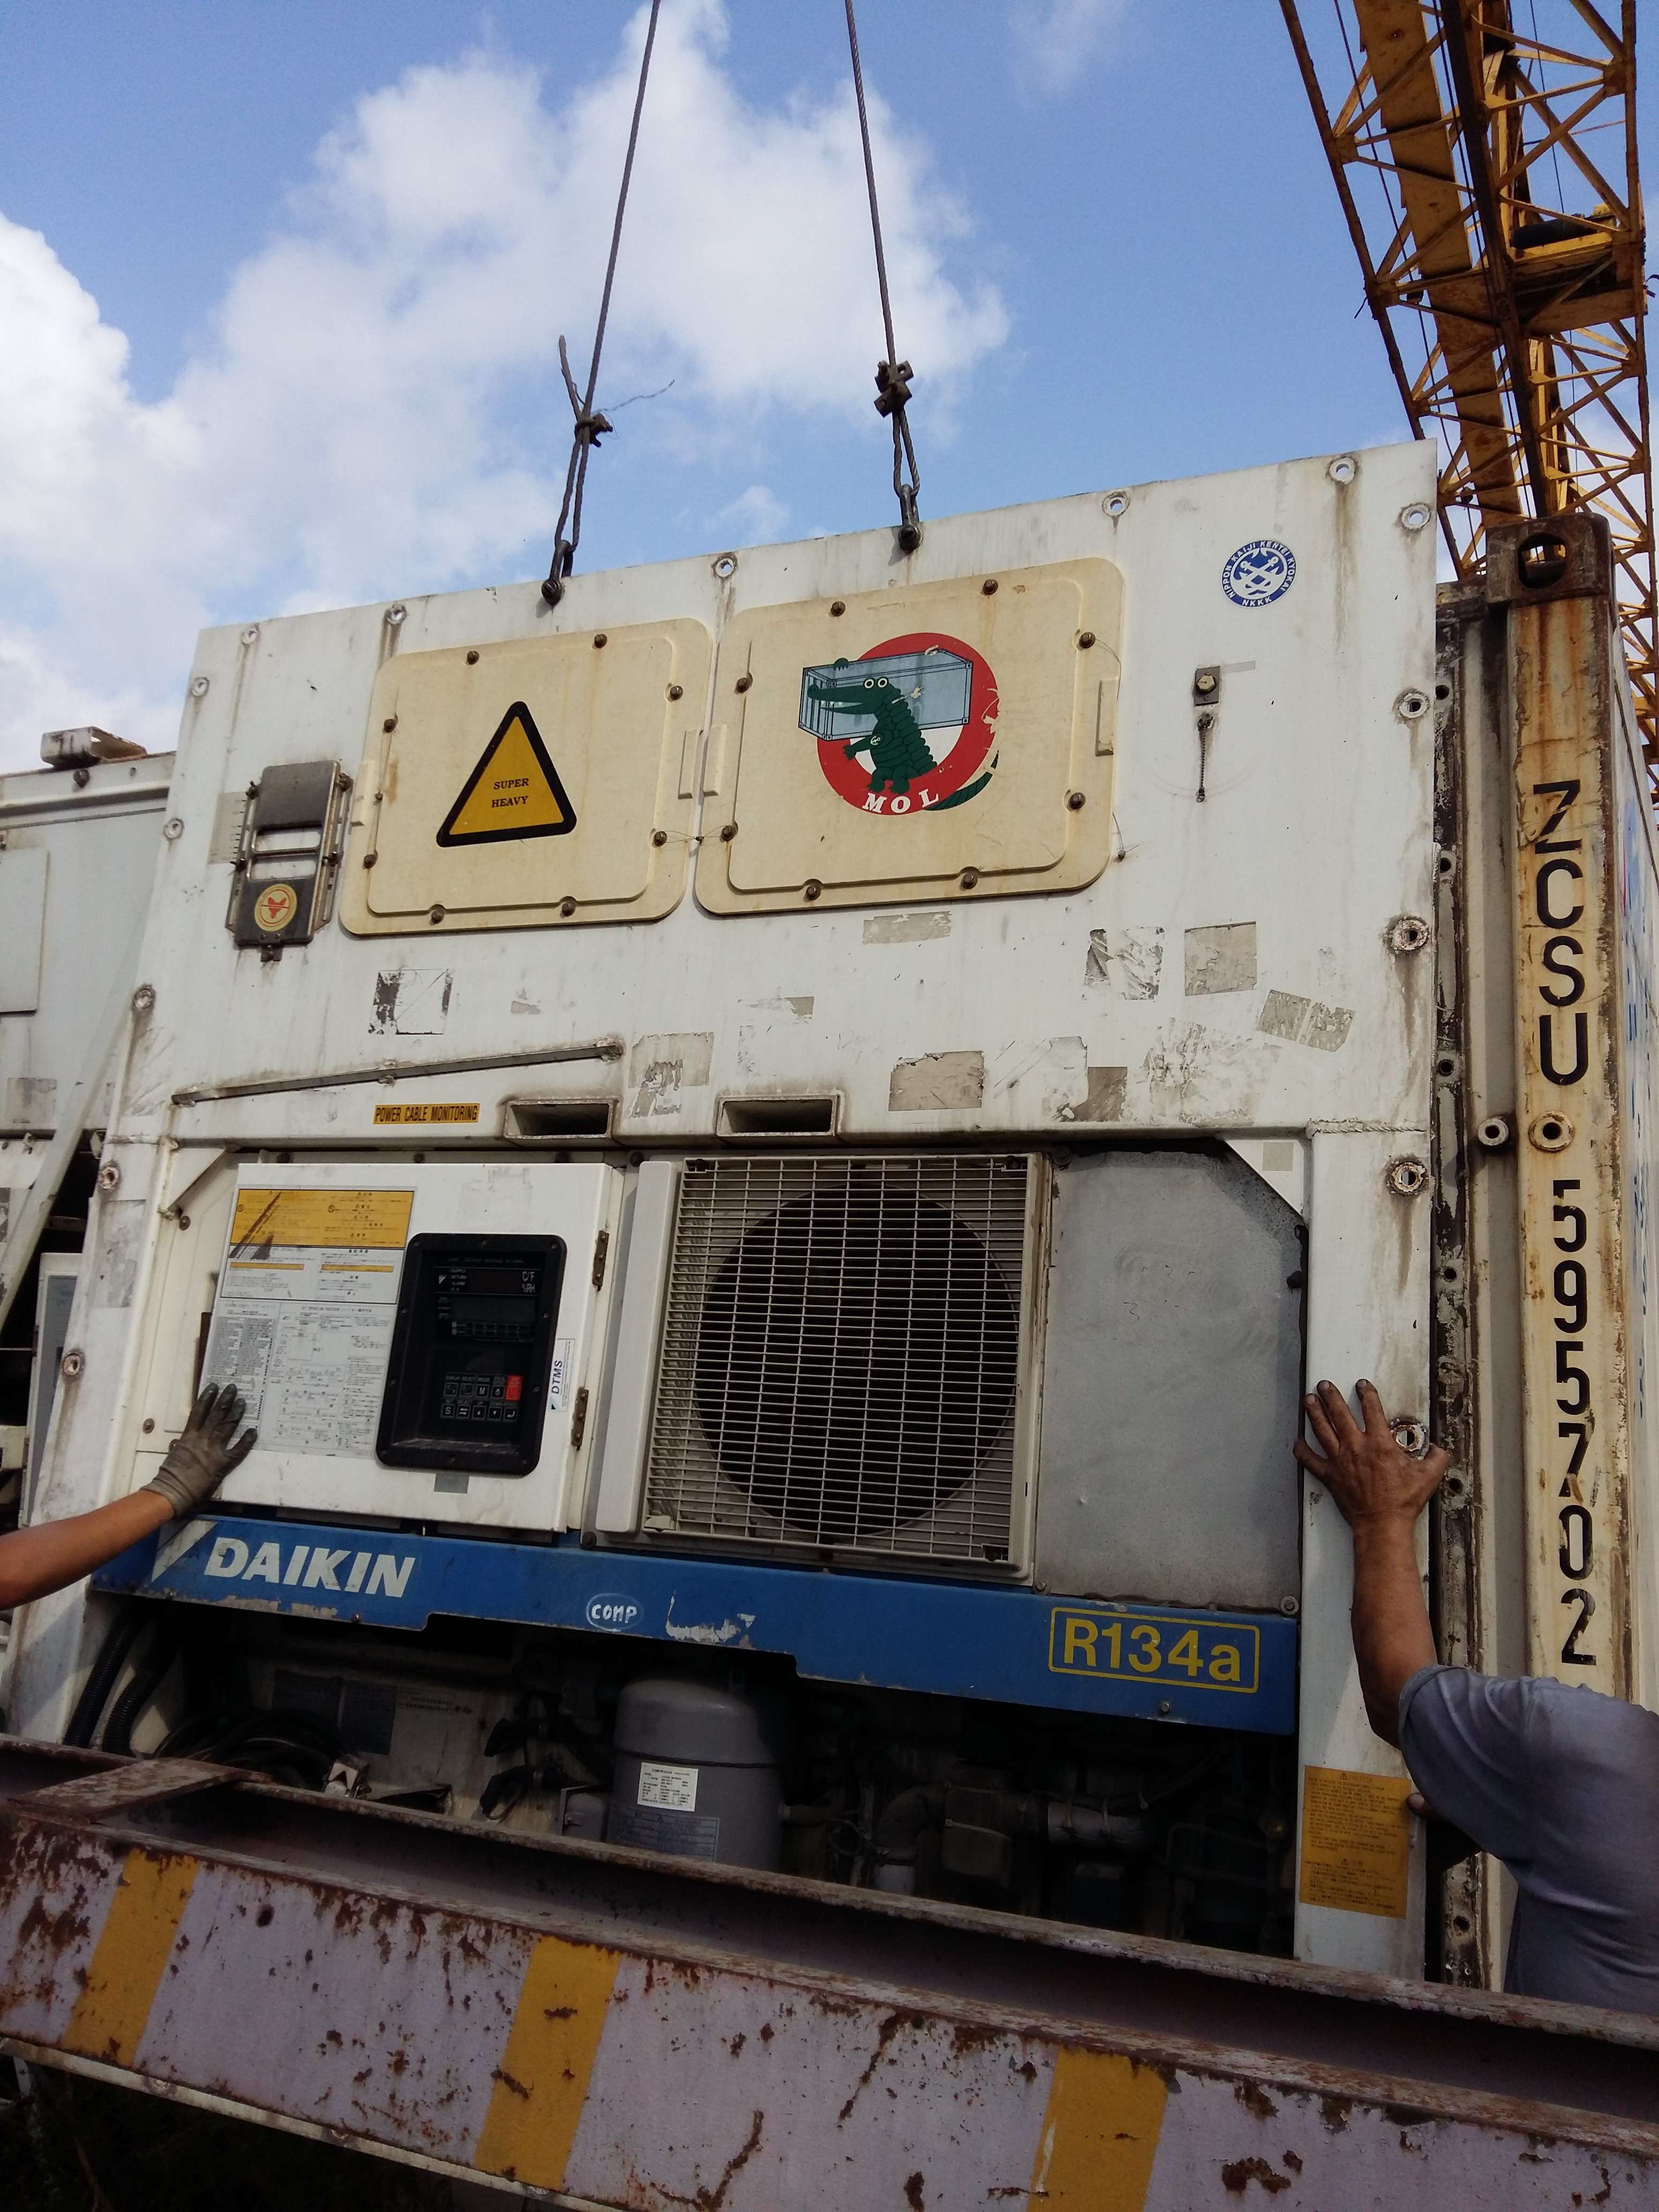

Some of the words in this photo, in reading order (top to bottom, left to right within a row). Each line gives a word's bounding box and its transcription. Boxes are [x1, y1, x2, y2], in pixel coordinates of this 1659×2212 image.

[1223, 565, 1235, 598] NIPPON
[1231, 543, 1256, 562] KAIJI
[1260, 541, 1290, 556] KENTEI
[1281, 557, 1295, 591] KYOKAI
[1242, 596, 1272, 607] NKKK
[494, 778, 529, 790] SUPER
[491, 796, 529, 808] HEAVY
[862, 789, 939, 814] MOL
[1533, 779, 1588, 1086] ZCSU
[375, 1107, 401, 1122] POWER
[405, 1107, 428, 1122] CABLE
[430, 1105, 477, 1121] MONITORING
[552, 1360, 562, 1394] DTMS
[204, 1537, 416, 1598] DAIKIN
[1064, 1618, 1240, 1682] R134a
